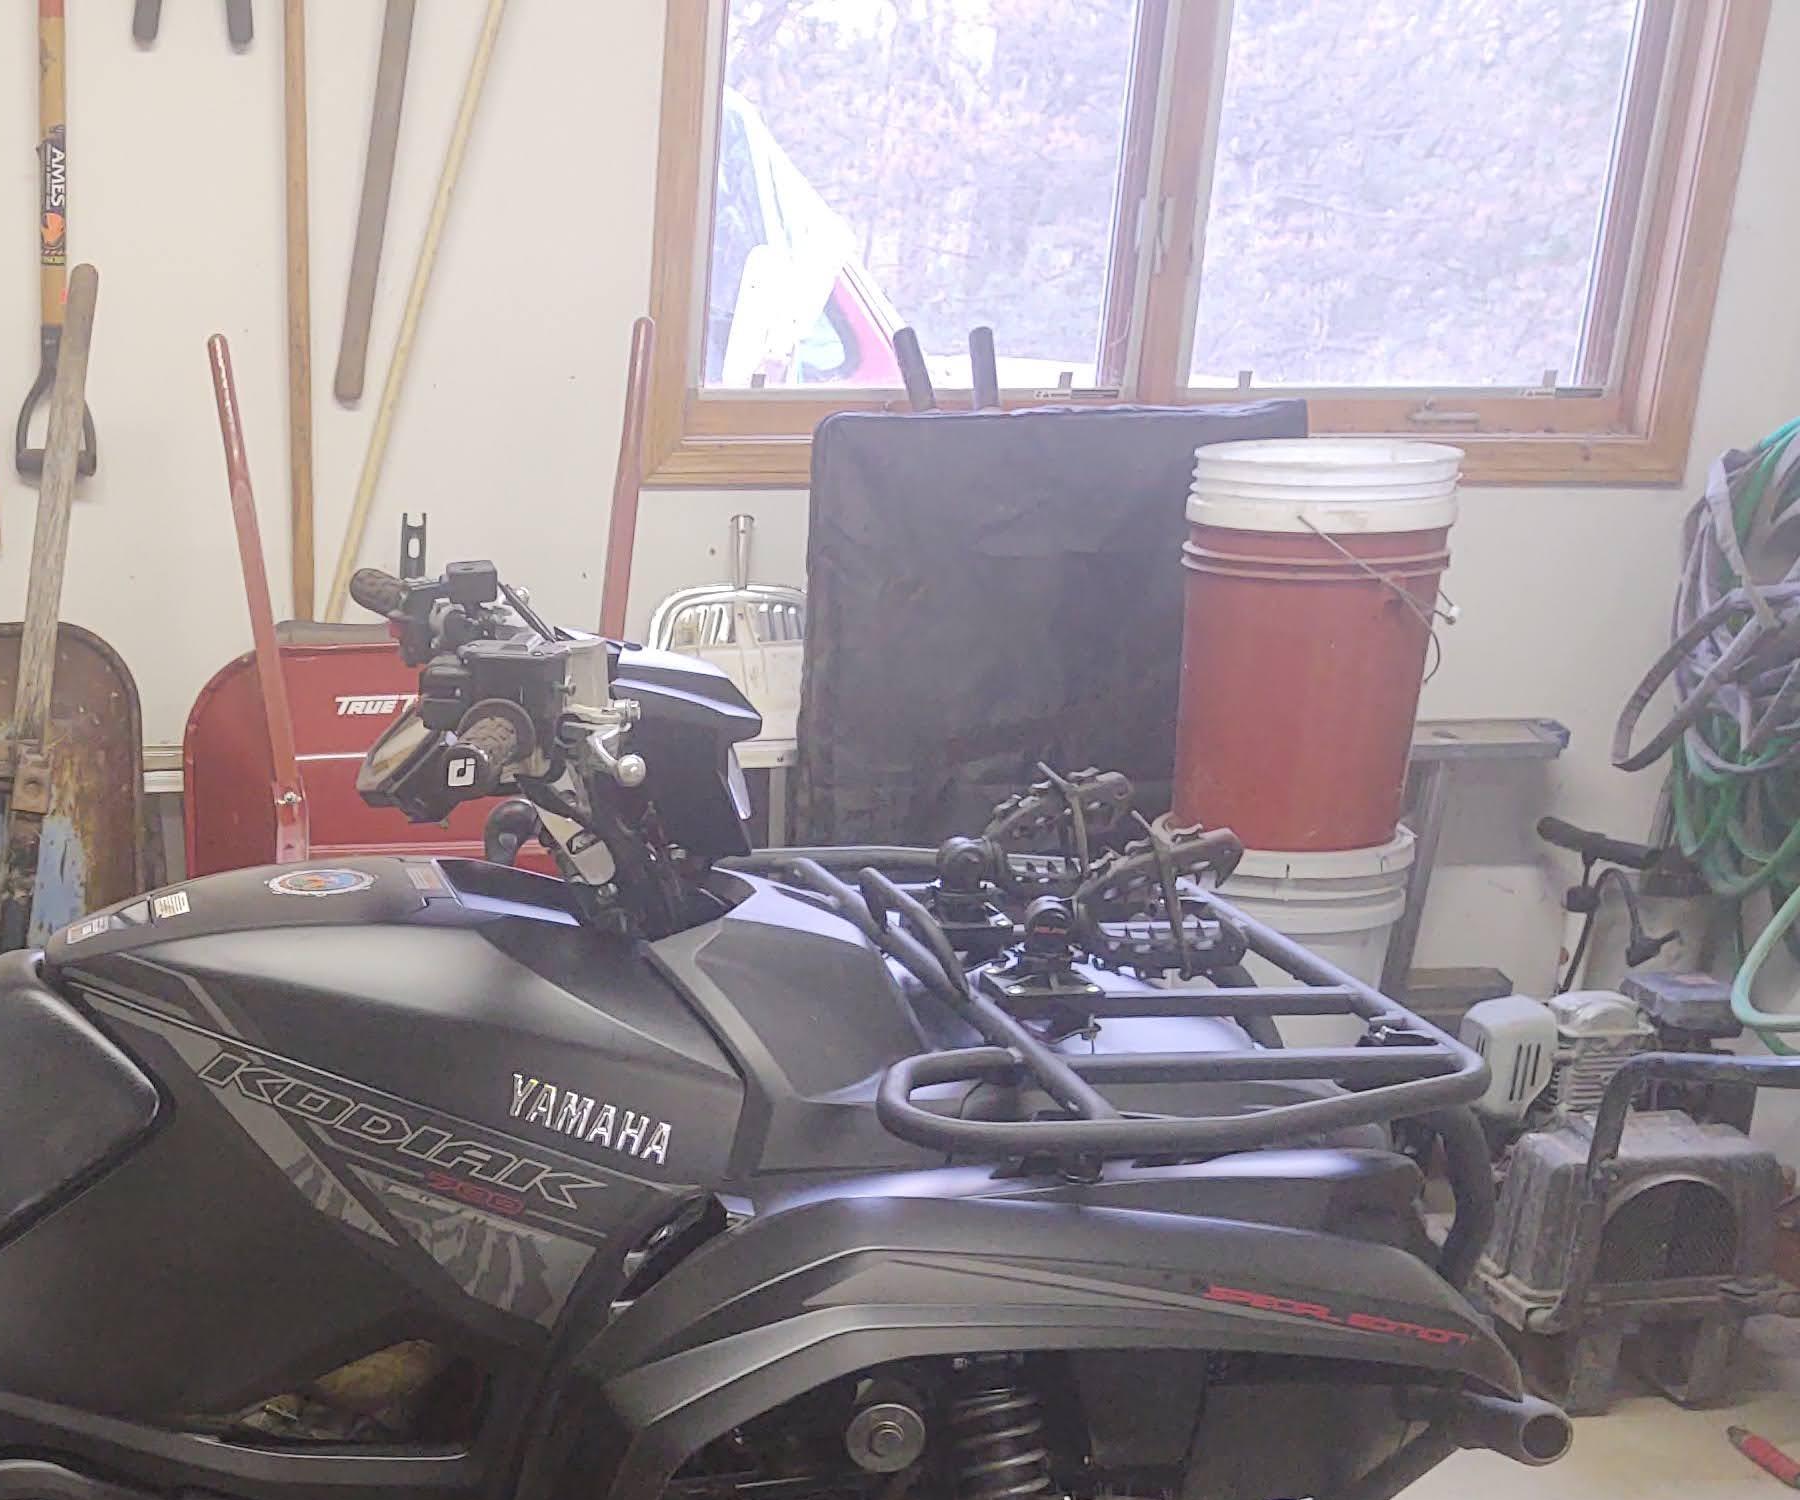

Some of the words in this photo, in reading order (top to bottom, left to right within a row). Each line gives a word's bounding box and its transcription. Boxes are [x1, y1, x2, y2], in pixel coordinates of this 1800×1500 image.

[51, 147, 66, 207] AMES
[334, 694, 400, 716] TRUE
[199, 1050, 608, 1210] KODIAK
[508, 1072, 674, 1166] YAMAHA
